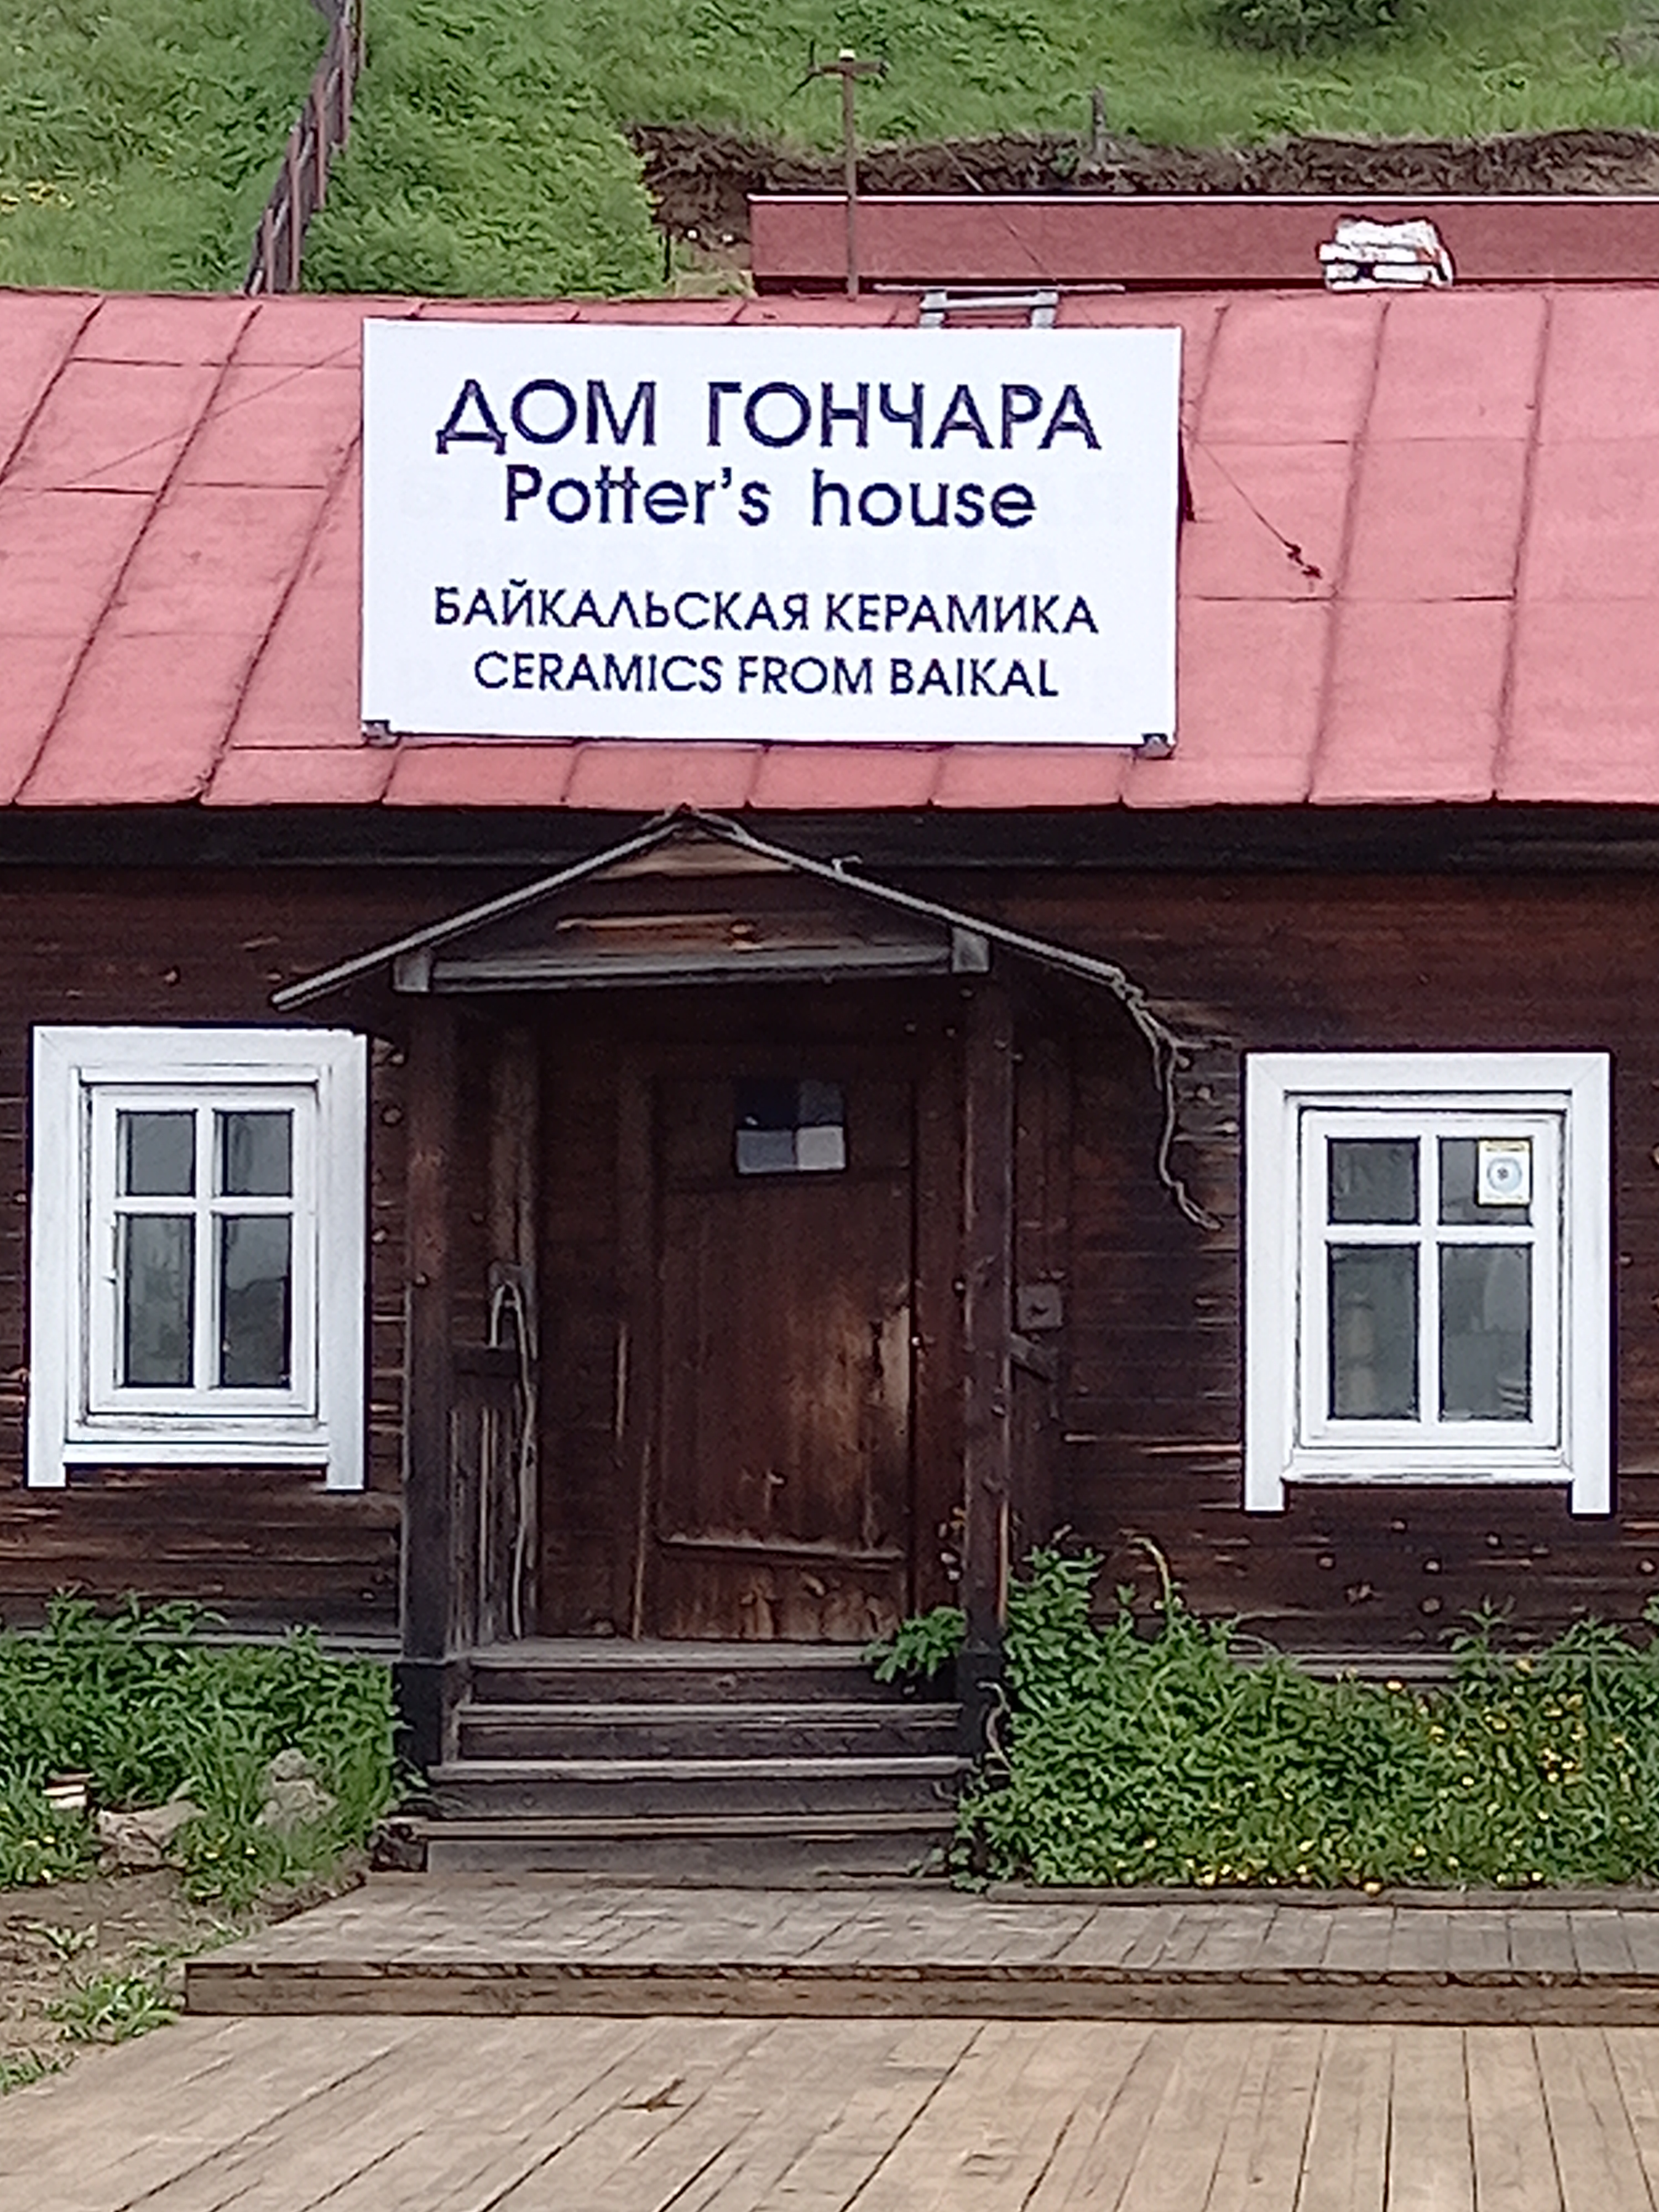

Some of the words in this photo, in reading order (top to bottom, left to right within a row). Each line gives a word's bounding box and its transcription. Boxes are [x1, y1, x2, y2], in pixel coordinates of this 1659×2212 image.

[435, 378, 657, 456] ДОМ
[707, 381, 1103, 451] ГОНЧАРА
[504, 463, 771, 527] Potter's
[812, 467, 1037, 529] house
[434, 578, 810, 632] БАЙКАЛЬСКАЯ
[825, 592, 1099, 634] КЕРАМИКА
[474, 650, 723, 694] CERAMICS
[738, 655, 873, 695] FROM
[890, 658, 1059, 697] BAIKAL
